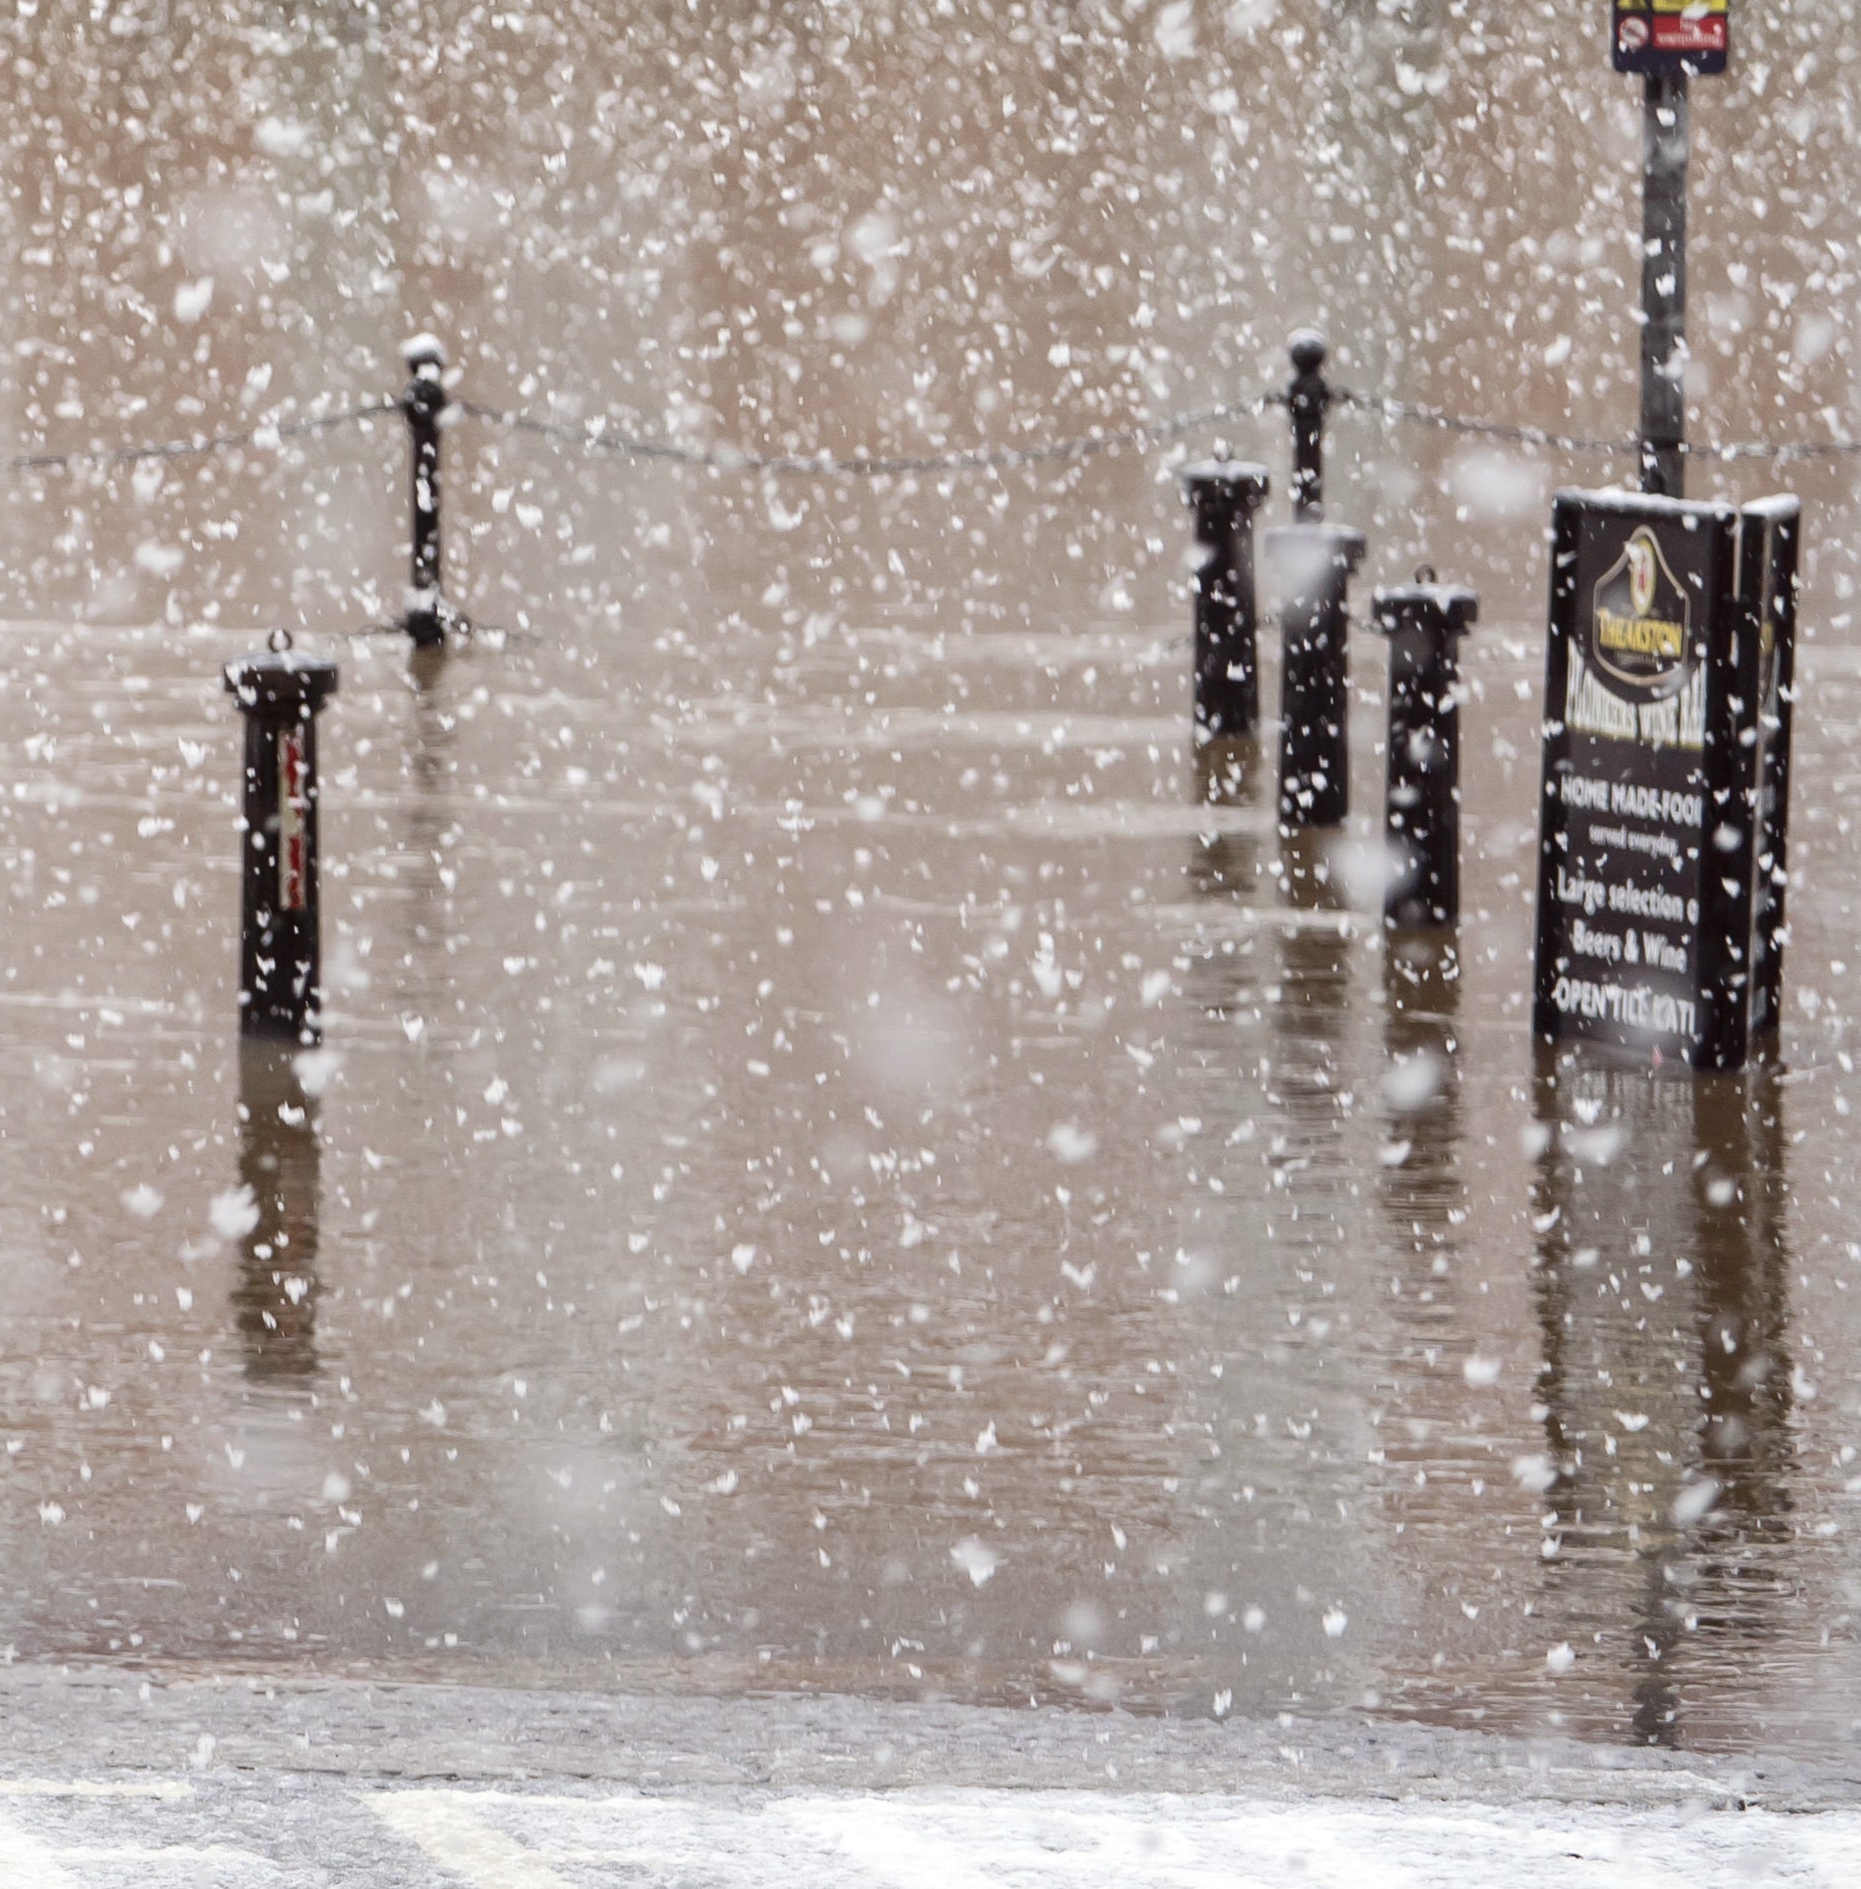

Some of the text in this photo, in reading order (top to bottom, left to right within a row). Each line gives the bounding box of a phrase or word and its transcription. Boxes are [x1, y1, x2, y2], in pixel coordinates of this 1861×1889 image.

[1639, 696, 1678, 746] WINE
[1561, 773, 1610, 811] HOME
[1611, 782, 1660, 821] MADE
[1557, 863, 1606, 915] Large
[1609, 878, 1684, 922] selection
[1572, 918, 1688, 973] Beers & Wine
[1555, 976, 1607, 1019] OPEN
